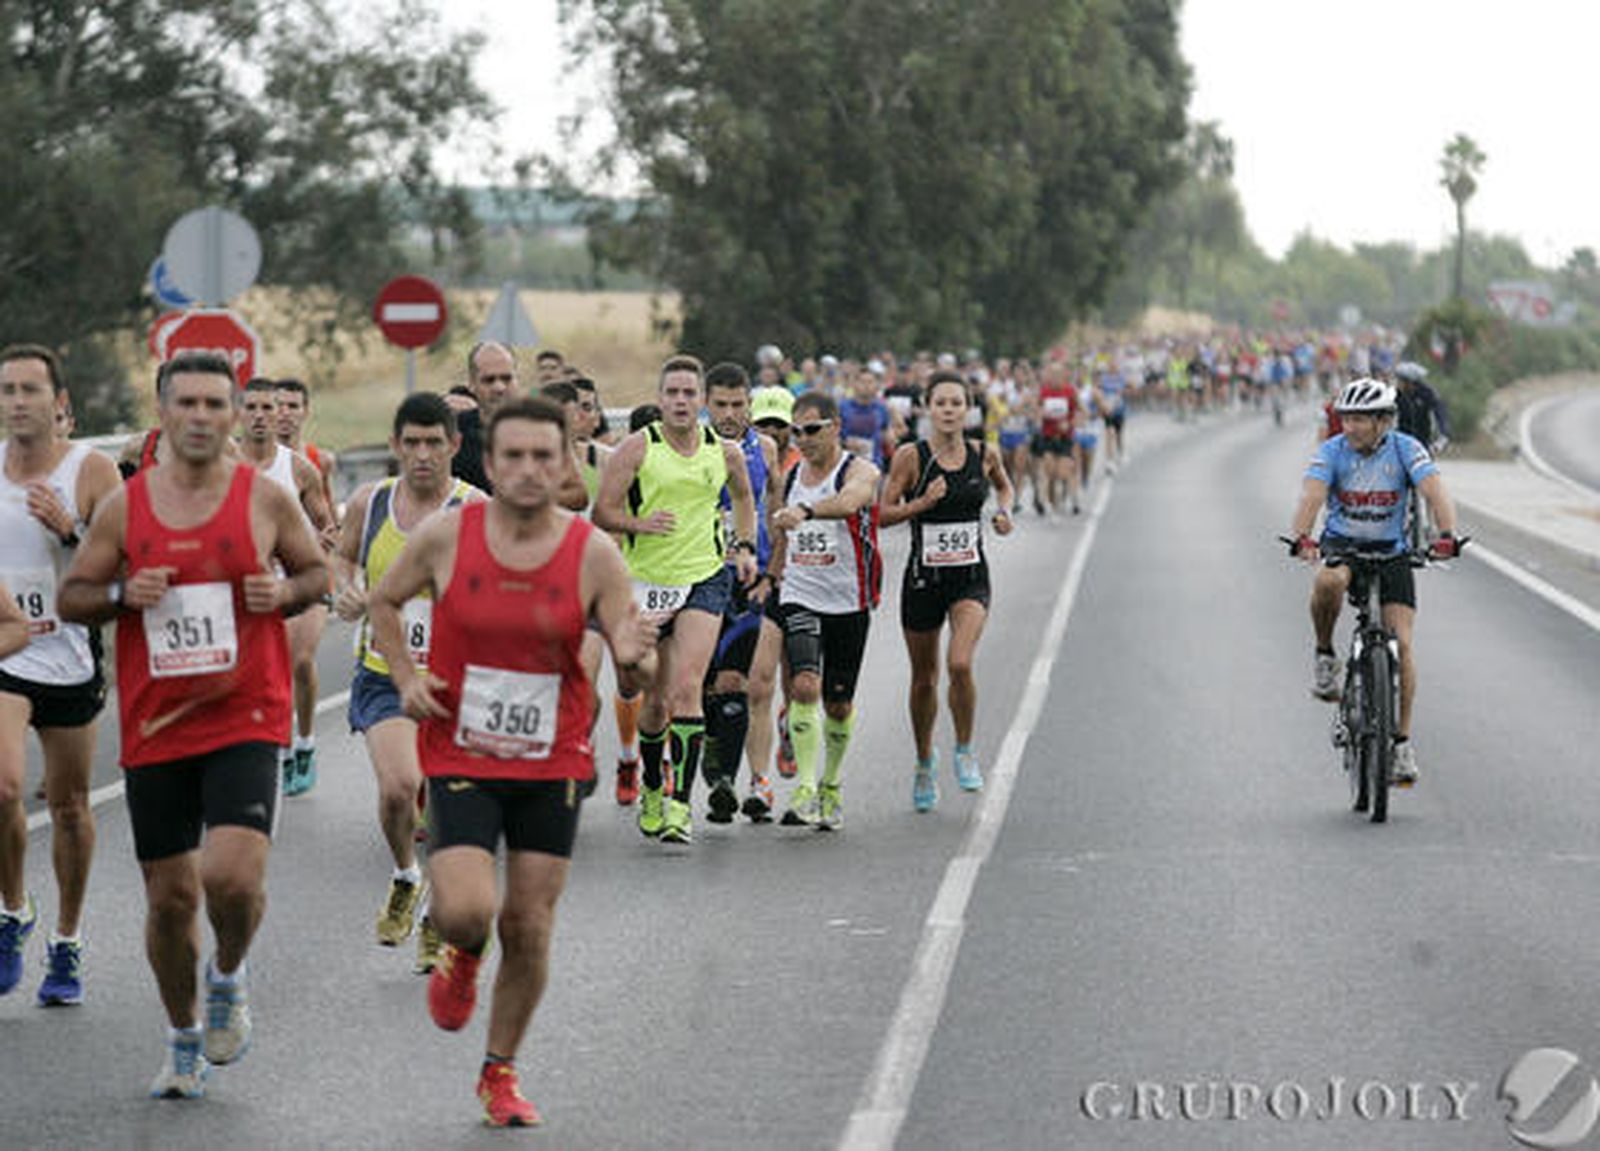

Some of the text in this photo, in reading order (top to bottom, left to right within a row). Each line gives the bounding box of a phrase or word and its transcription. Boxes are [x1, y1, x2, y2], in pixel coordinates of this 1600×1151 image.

[165, 616, 214, 650] 351
[405, 622, 424, 648] 8
[485, 700, 541, 735] 350
